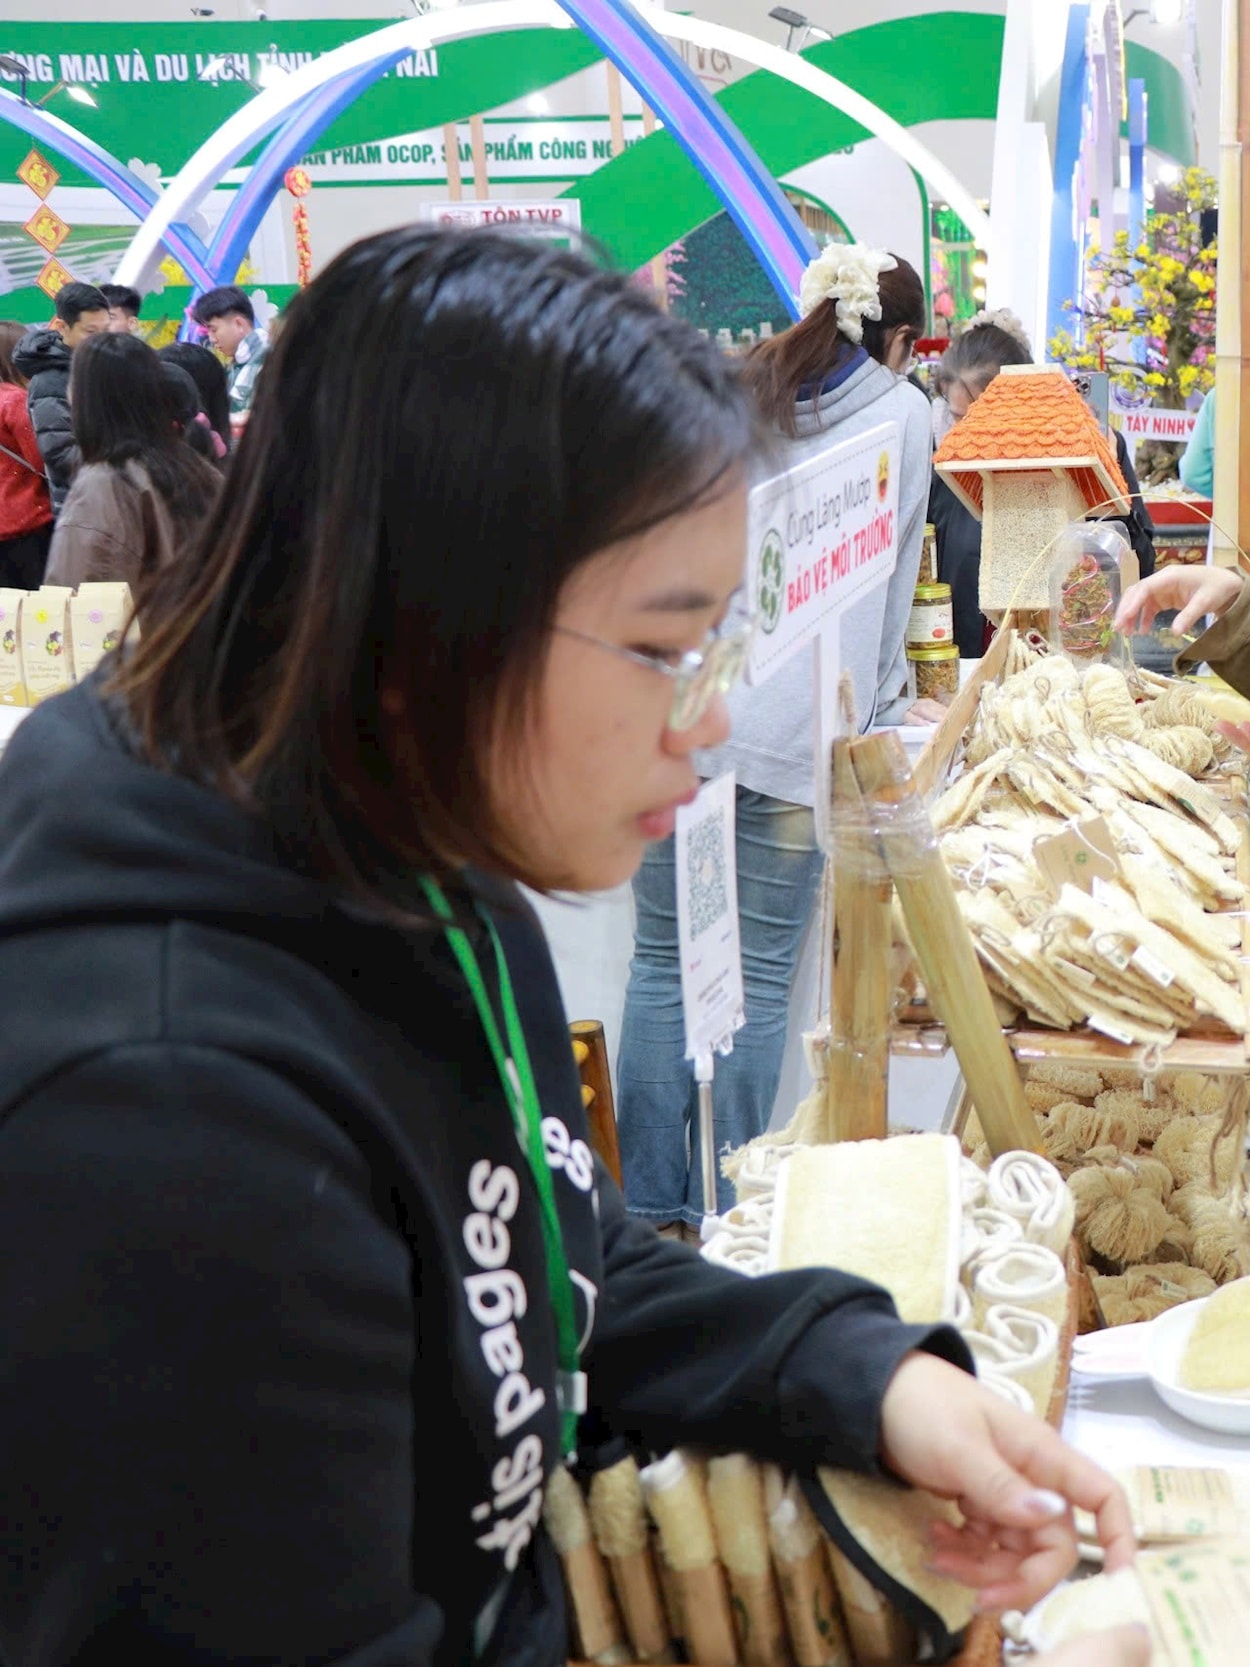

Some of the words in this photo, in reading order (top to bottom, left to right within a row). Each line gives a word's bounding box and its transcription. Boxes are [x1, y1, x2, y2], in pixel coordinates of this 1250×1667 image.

[58, 53, 110, 88] MẠI
[114, 48, 150, 82] VÀ
[154, 53, 189, 82] DU
[387, 144, 436, 165] OCOP,
[539, 137, 588, 160] CÔNG
[481, 206, 521, 224] TÔN
[1153, 416, 1185, 435] NINH
[787, 563, 811, 614] BẢO
[814, 546, 827, 597] VỆ
[831, 531, 851, 585] MÔI
[854, 506, 893, 569] TRƯỜNG
[462, 1158, 546, 1437] pages
